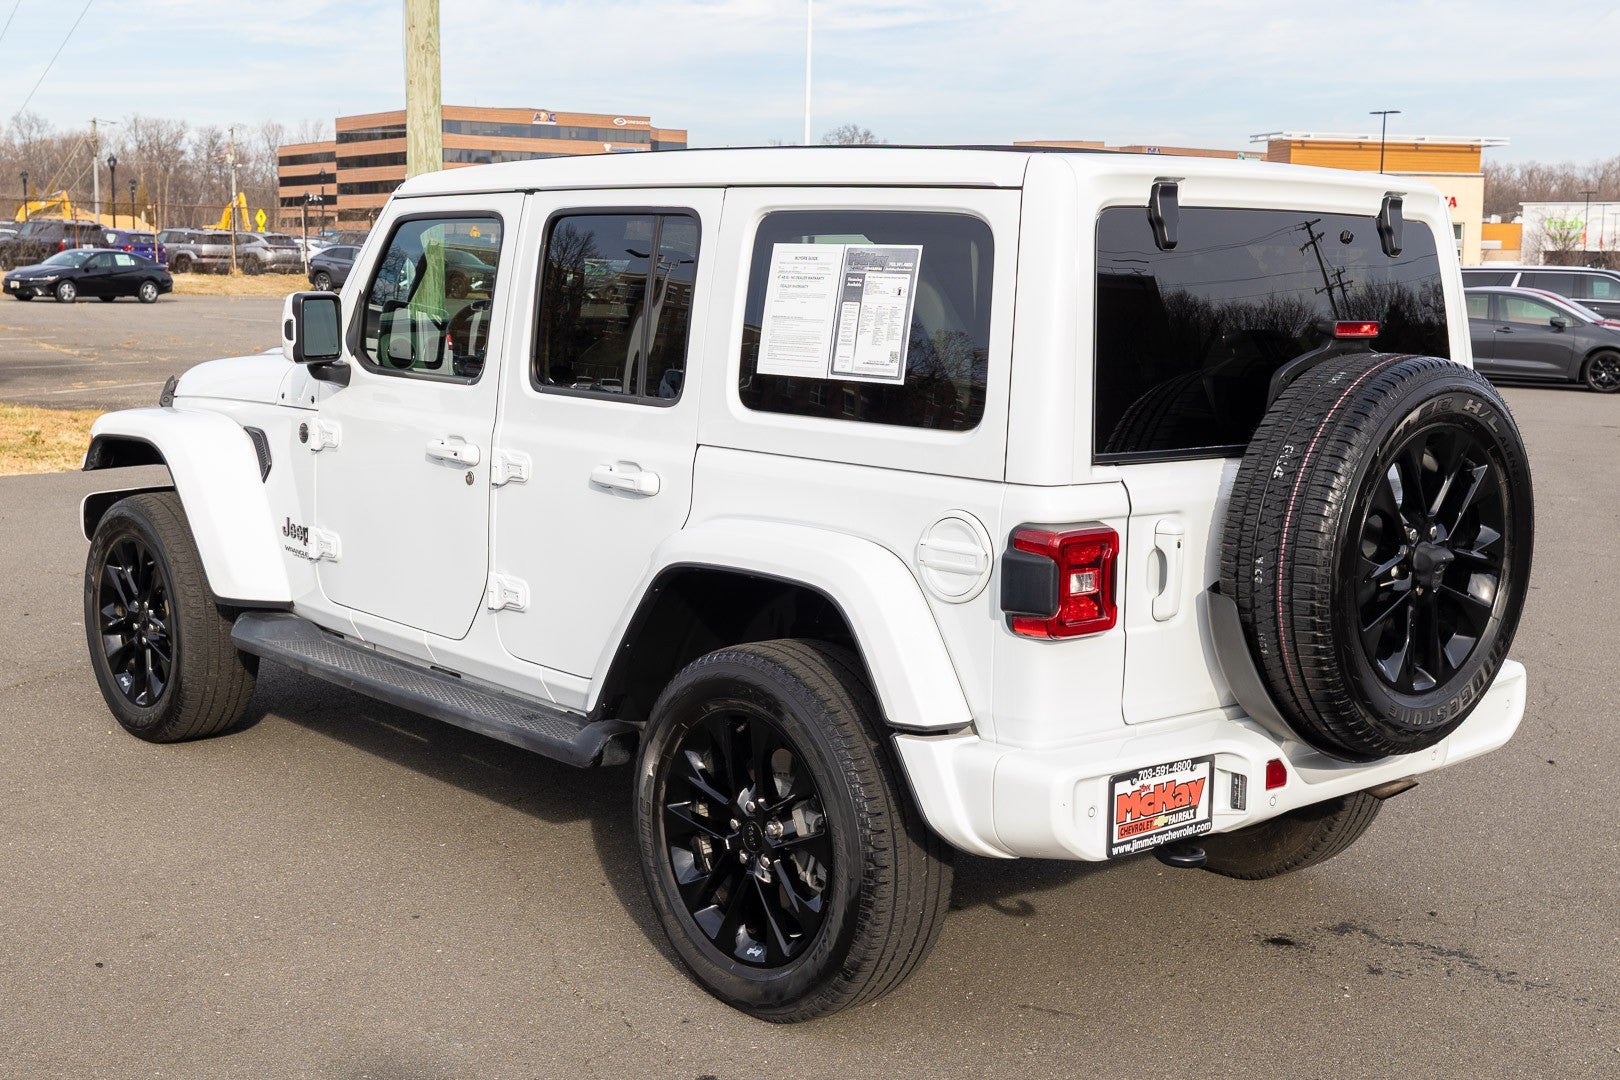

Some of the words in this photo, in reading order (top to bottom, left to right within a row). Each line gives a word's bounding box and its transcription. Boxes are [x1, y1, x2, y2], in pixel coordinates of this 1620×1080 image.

[282, 516, 309, 547] Jeep
[1138, 759, 1192, 781] 703-591-4800
[1116, 777, 1206, 824] McKay
[1120, 820, 1153, 837] CHEVROLET
[1168, 808, 1195, 825] FAIRFAX
[1112, 822, 1212, 856] www.jimmckaychevrolet.com
